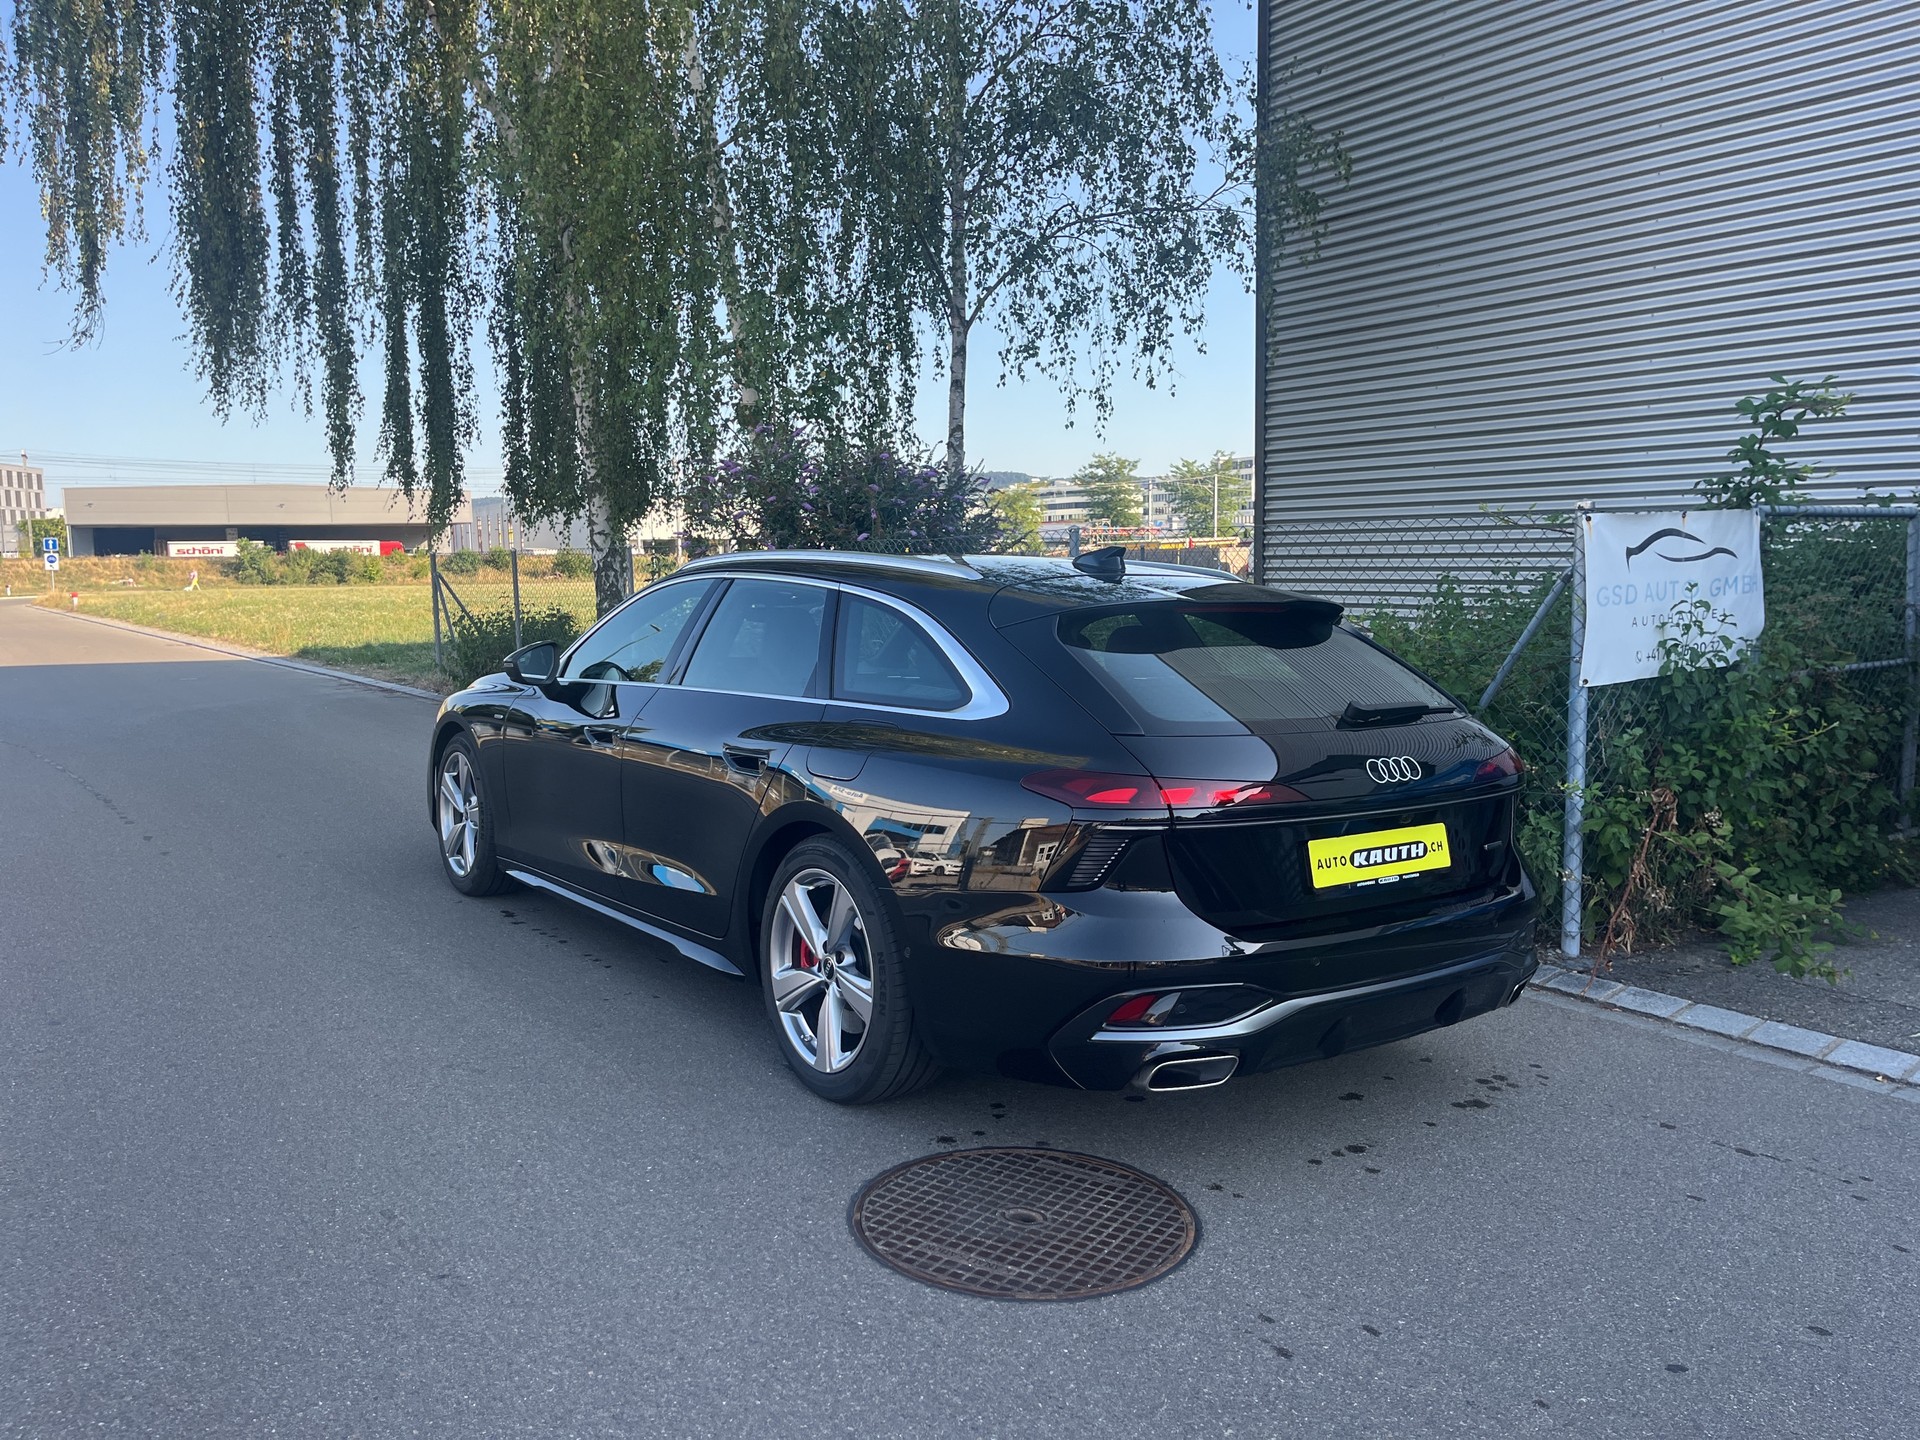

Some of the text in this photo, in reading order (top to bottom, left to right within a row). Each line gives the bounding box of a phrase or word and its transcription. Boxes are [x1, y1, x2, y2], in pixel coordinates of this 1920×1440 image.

[1596, 584, 1638, 607] GSD
[1644, 579, 1700, 602] AUTO
[1317, 855, 1347, 870] AUTO
[1353, 842, 1425, 867] KAUTH
[876, 951, 887, 1017] NEXEN
